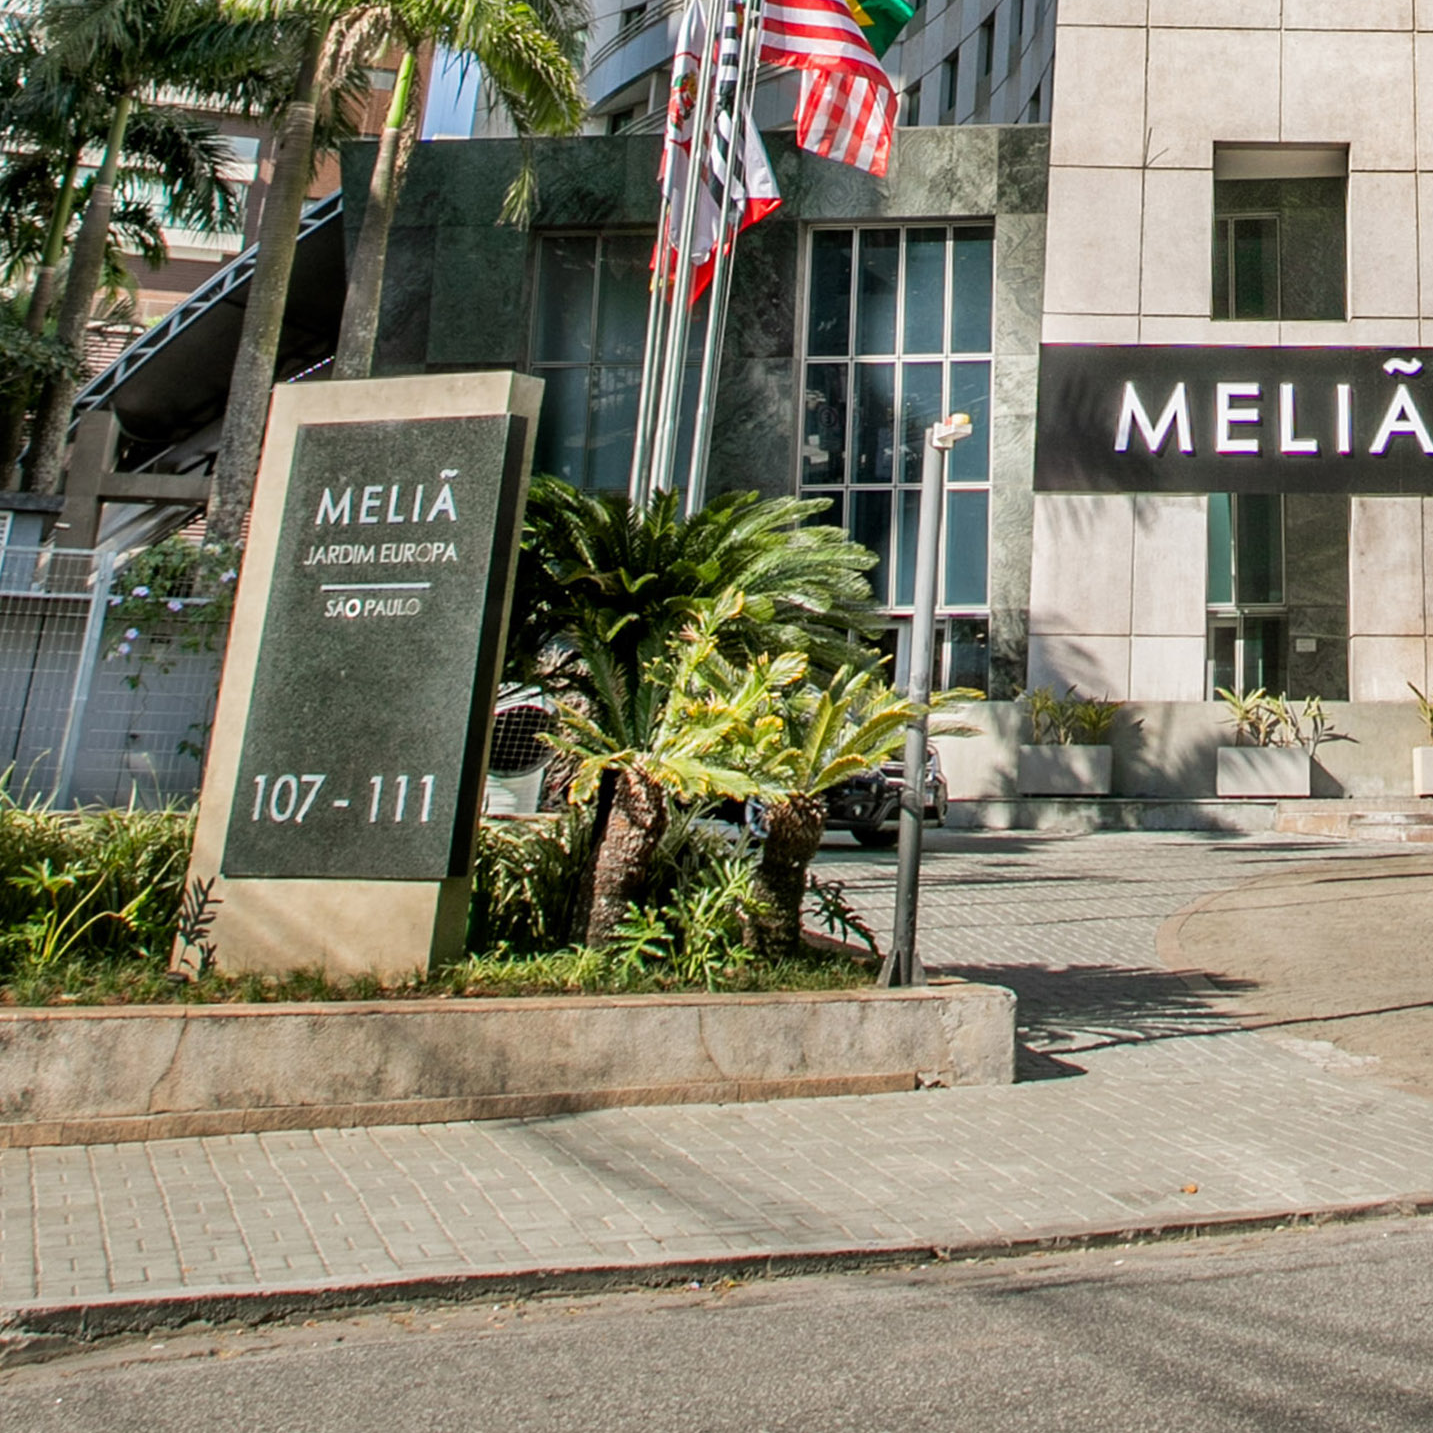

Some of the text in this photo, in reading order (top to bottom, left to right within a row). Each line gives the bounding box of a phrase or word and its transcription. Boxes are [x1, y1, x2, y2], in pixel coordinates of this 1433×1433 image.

[314, 469, 459, 526] MELIÃ
[303, 543, 458, 565] JARDIM EUROPA
[324, 596, 421, 618] SÃO PAULO
[252, 774, 328, 823] 107
[369, 774, 436, 823] 111
